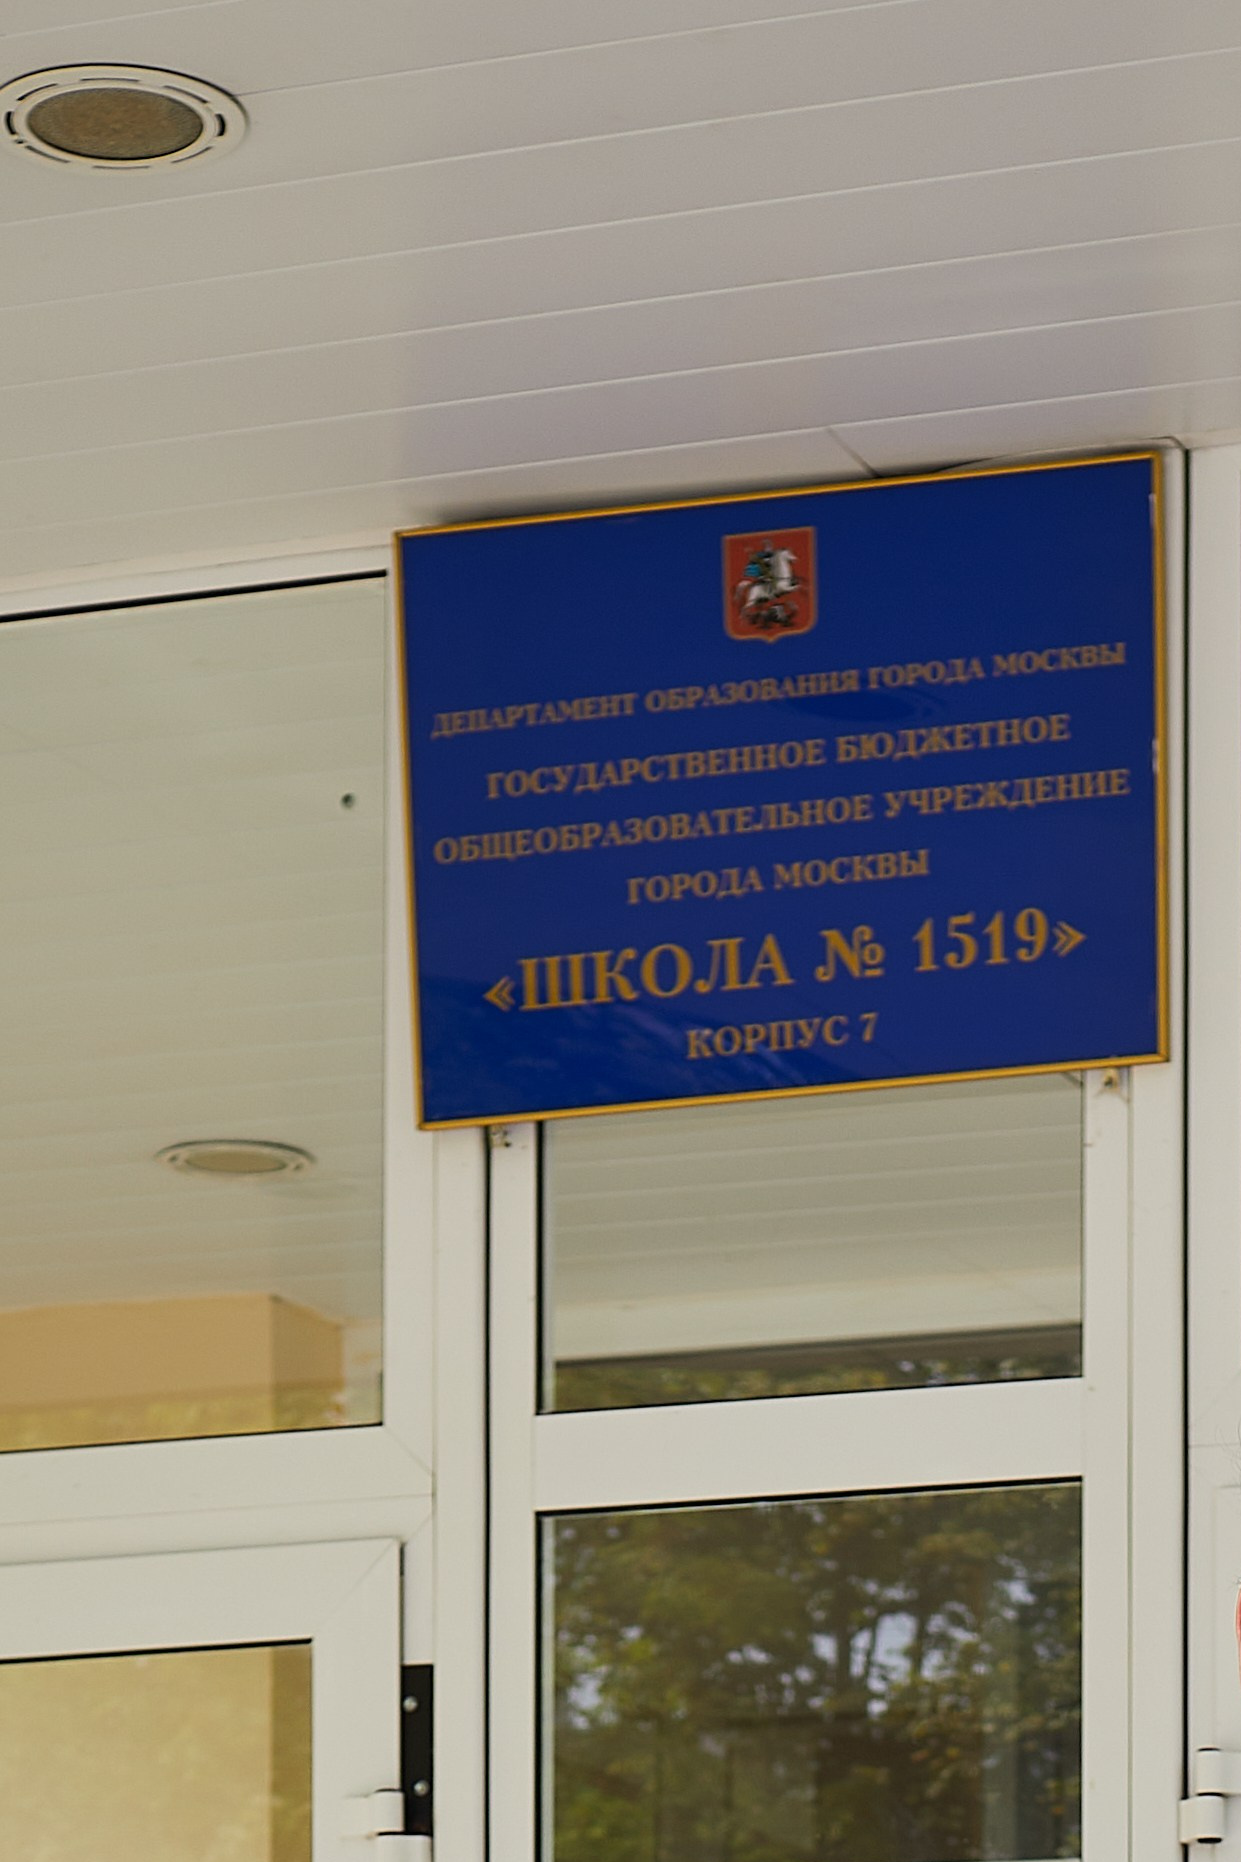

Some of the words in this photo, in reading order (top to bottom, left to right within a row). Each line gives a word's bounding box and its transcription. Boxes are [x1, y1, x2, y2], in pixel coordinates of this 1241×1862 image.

[431, 692, 638, 739] ДЕПАРТАМЕНТ
[645, 669, 860, 713] ОБРАЗОВАНИЯ
[868, 656, 985, 689] ГОРОДА
[993, 642, 1126, 677] МОСКВЫ
[487, 738, 826, 799] ГОСУДАРСТВЕННОЕ
[836, 713, 1071, 763] БЮДЖЕТНОЕ
[433, 794, 873, 864] ОБЩЕОБРАЗОВАТЕЛЬНОЕ
[884, 768, 1131, 819] УЧРЕЖДЕНИЕ
[627, 867, 764, 905] ГОРОДА
[773, 848, 929, 890] МОСКВЫ
[484, 933, 795, 1011] «ШКОЛА
[814, 924, 886, 983] №
[913, 907, 1087, 973] 1519»
[687, 1015, 849, 1060] КОРПУС
[859, 1011, 878, 1043] 7
